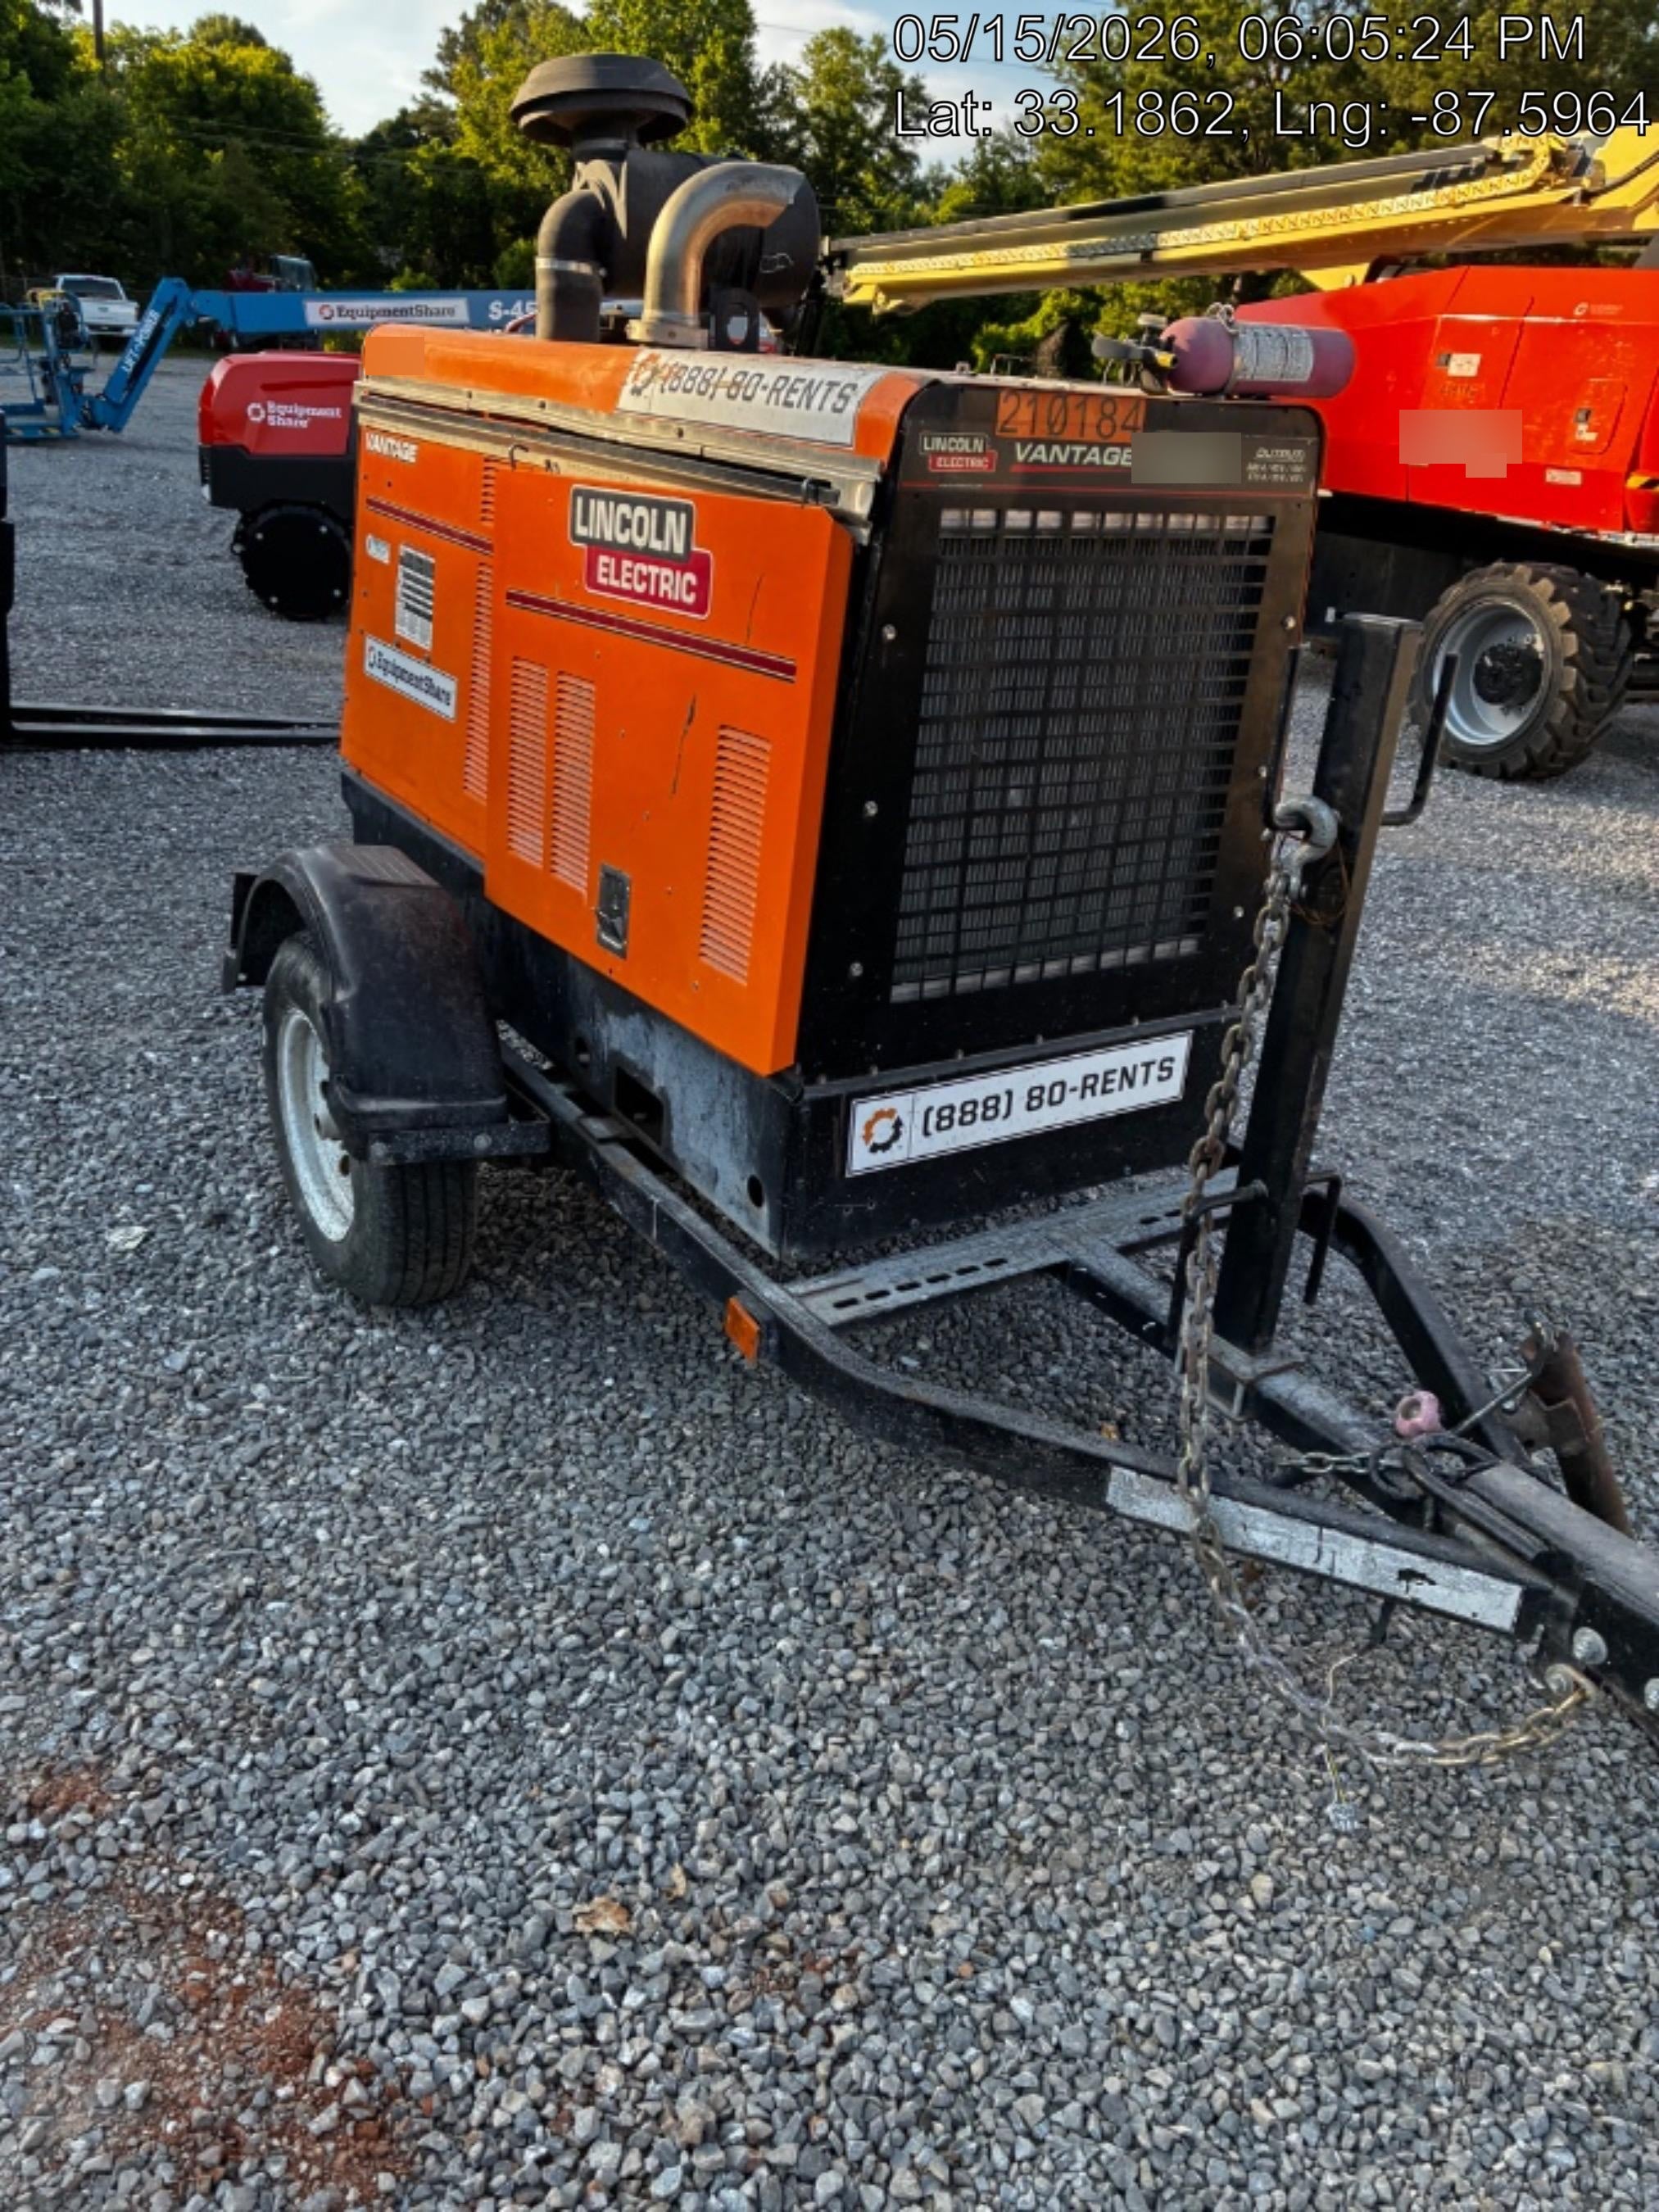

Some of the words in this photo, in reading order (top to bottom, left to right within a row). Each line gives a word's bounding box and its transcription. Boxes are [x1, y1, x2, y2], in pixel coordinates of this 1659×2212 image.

[337, 303, 456, 320] EquipmentShare
[660, 363, 728, 401] (888)
[727, 369, 859, 414] 80-RENTS
[267, 400, 342, 419] Equipment
[267, 414, 308, 428] Share
[999, 389, 1144, 439] 210184
[365, 432, 419, 463] VANTAGE
[923, 436, 984, 453] LINCOLN
[1015, 442, 1132, 466] VANTAGE
[936, 456, 990, 469] ELECTRIC
[575, 496, 687, 555] LINCOLN
[596, 555, 697, 605] ELECTRIC
[922, 1090, 1013, 1137] (888)
[1024, 1056, 1176, 1112] 80-RENTS
